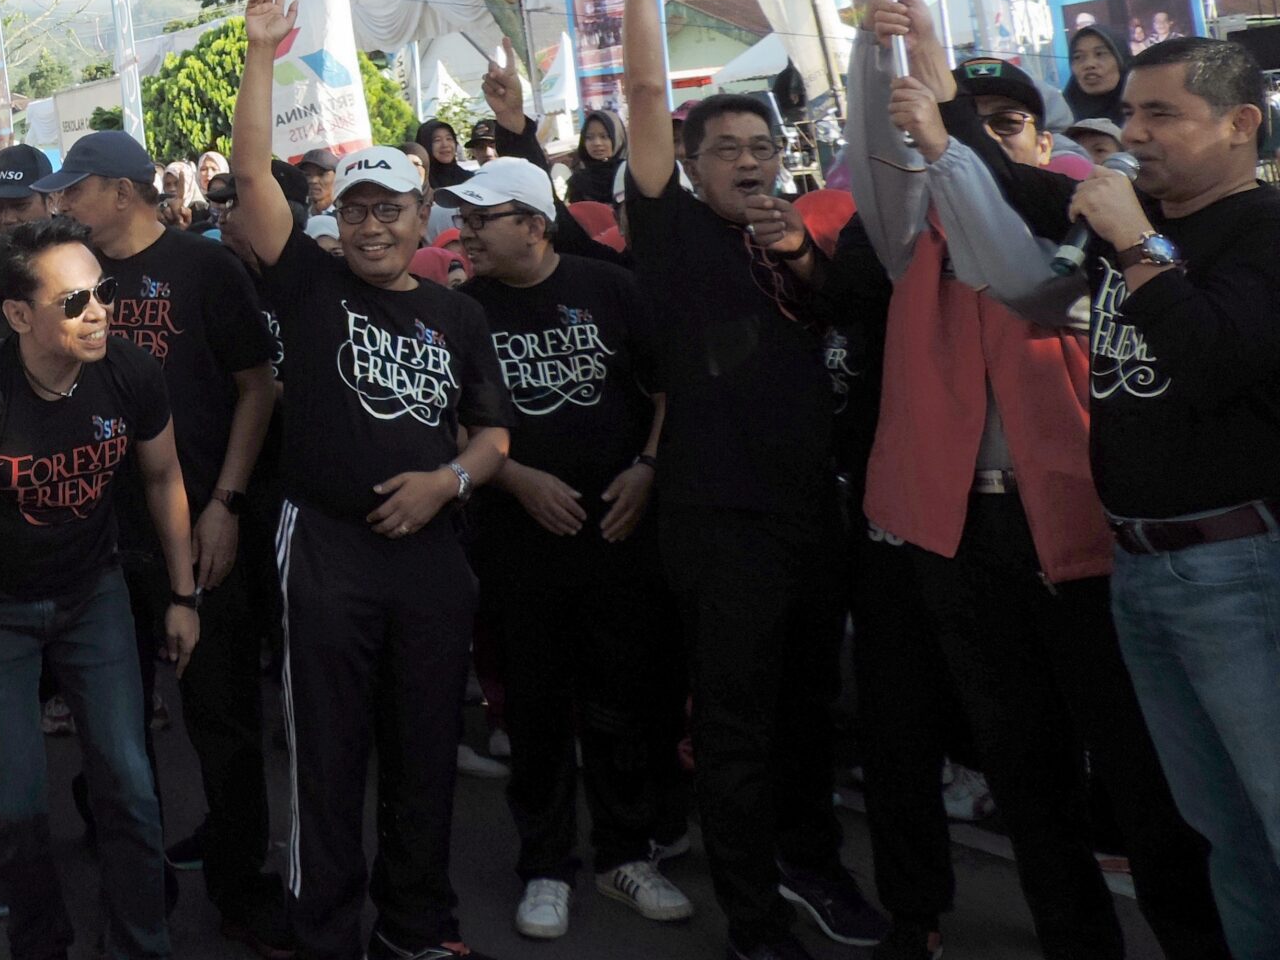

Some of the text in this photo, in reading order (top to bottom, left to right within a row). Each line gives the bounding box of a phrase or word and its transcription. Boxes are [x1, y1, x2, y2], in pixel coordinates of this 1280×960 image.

[344, 159, 392, 176] FILA
[342, 300, 460, 389] FOREVER
[491, 324, 617, 360] FOREVER
[349, 343, 450, 412] FRIENDS
[499, 352, 607, 394] FRIENDS
